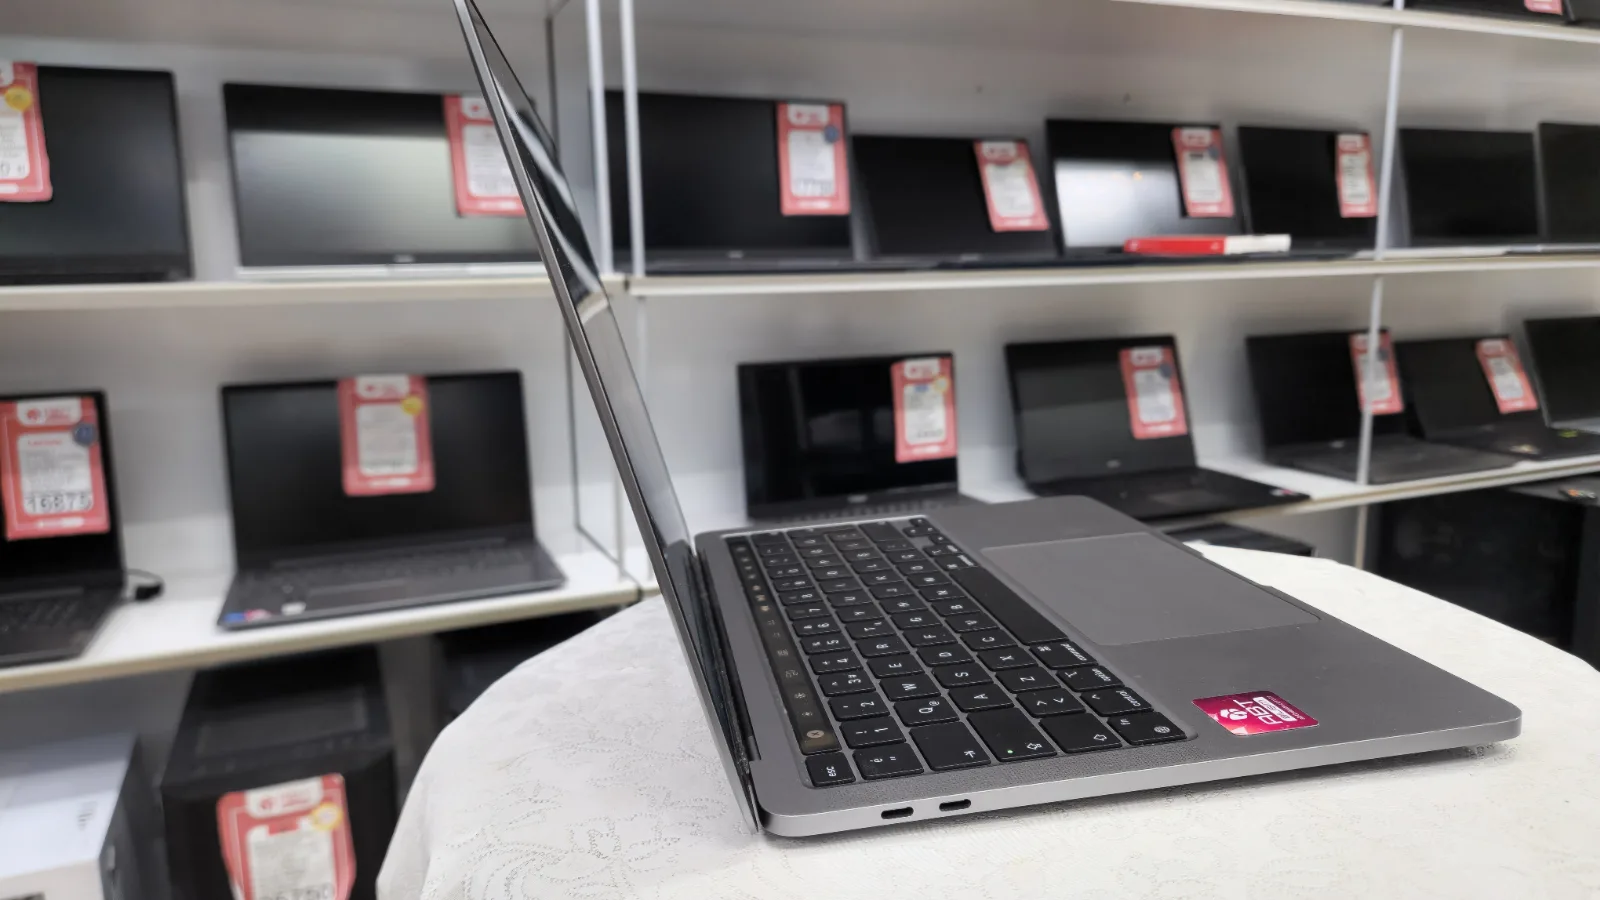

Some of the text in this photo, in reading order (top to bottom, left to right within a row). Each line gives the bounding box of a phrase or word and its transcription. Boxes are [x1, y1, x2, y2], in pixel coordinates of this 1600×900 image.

[1060, 643, 1088, 661] command
[1092, 667, 1112, 682] option
[901, 683, 917, 691] W
[1115, 690, 1141, 707] control
[1232, 699, 1284, 725] ABT
[1120, 718, 1131, 726] fn
[825, 765, 837, 777] esc
